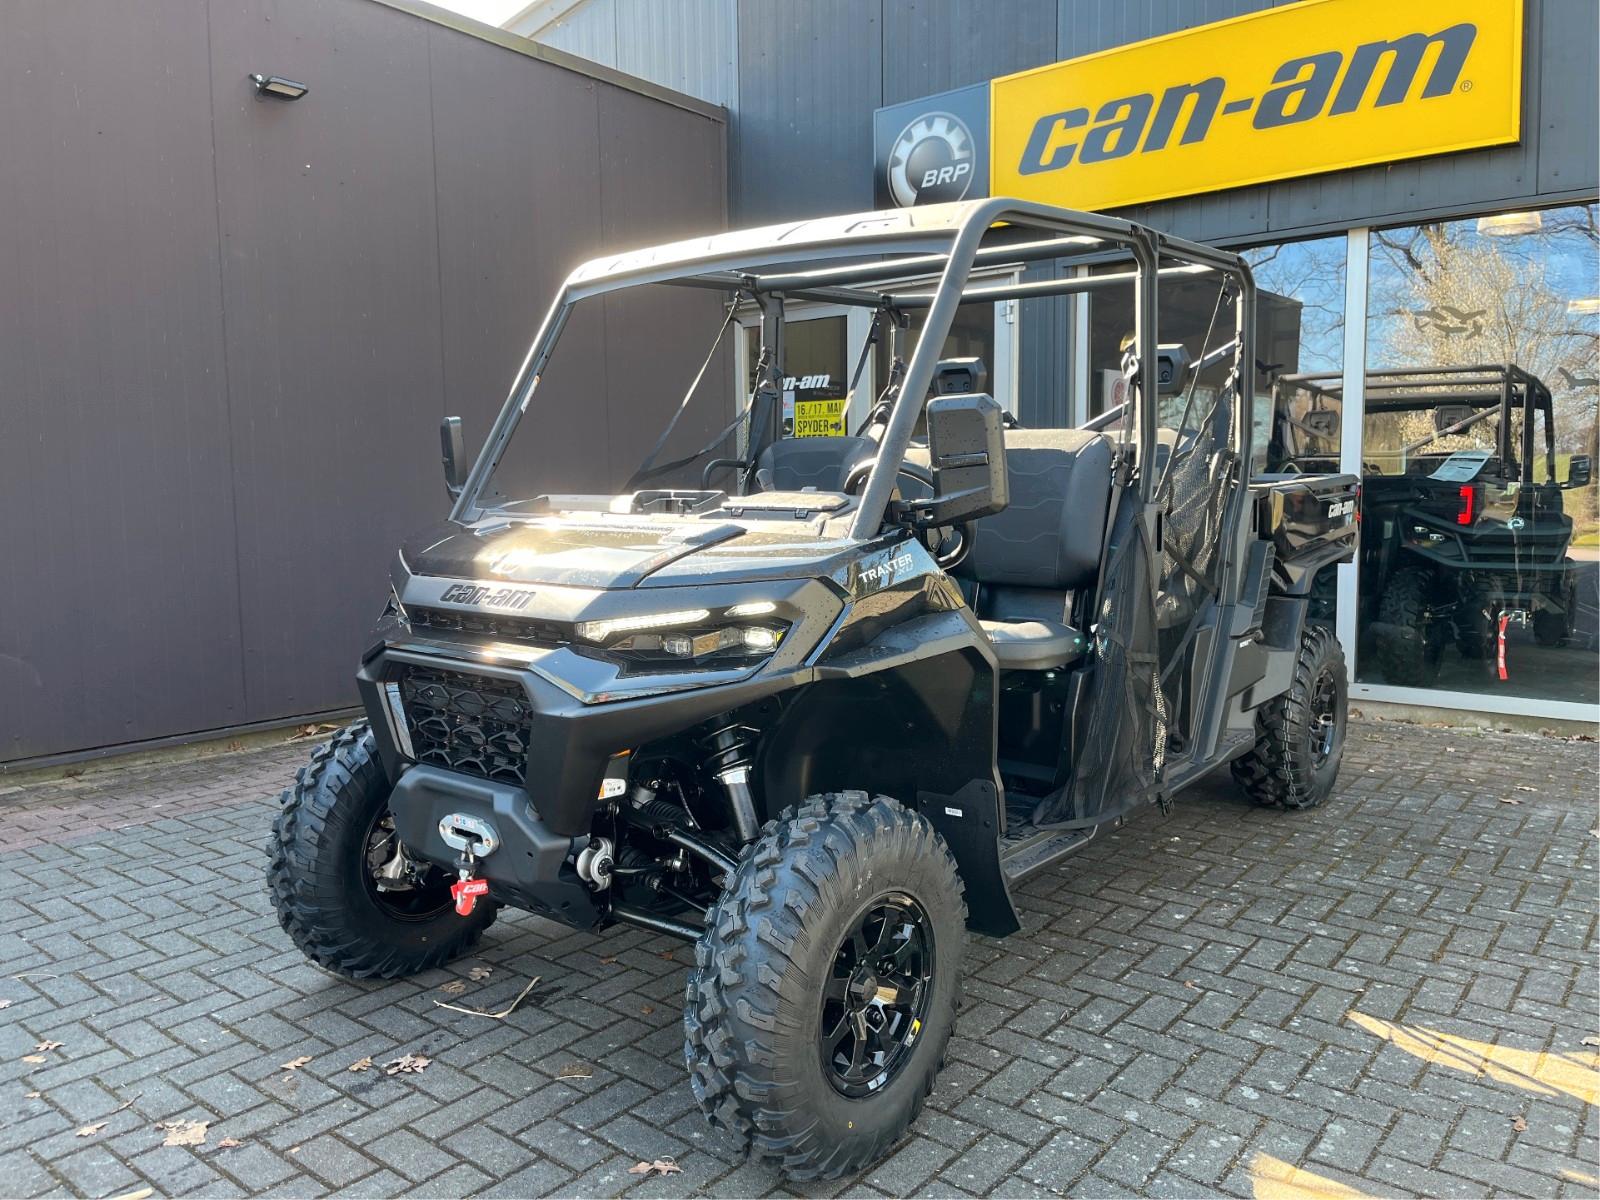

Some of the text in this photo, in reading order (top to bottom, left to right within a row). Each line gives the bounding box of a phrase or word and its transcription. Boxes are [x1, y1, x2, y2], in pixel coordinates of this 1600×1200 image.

[921, 162, 970, 188] BRP
[782, 375, 830, 391] n-am
[797, 420, 829, 433] SPYDER
[858, 553, 913, 583] TRAXTER
[440, 583, 537, 609] can-am
